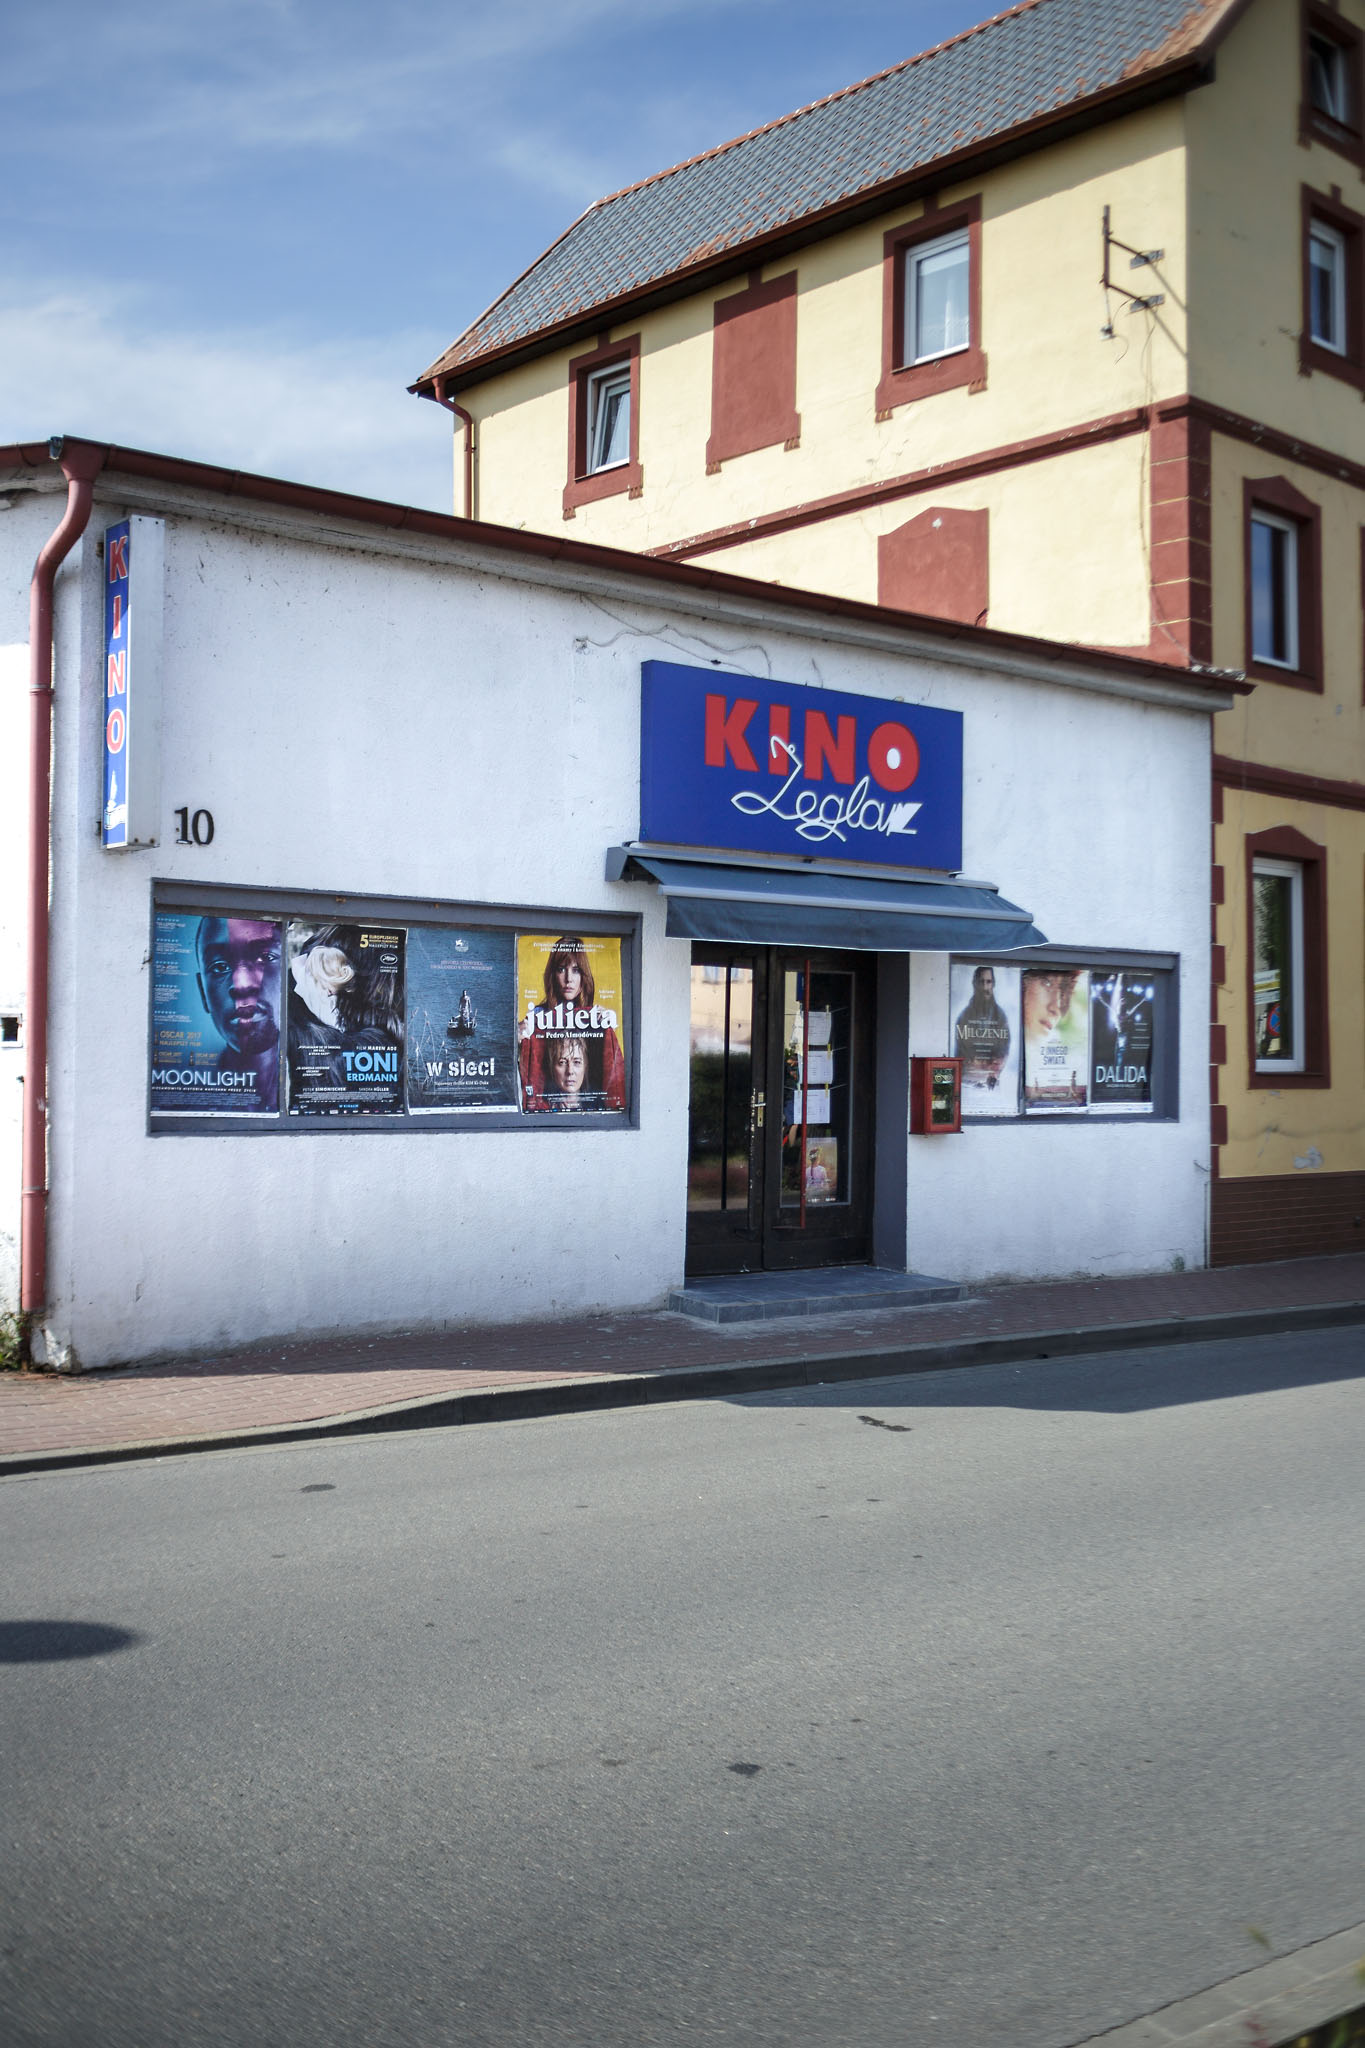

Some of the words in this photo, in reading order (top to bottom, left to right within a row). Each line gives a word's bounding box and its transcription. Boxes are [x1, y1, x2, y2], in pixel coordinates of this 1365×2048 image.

[107, 535, 128, 754] KINO
[704, 693, 920, 793] KINO
[731, 735, 923, 842] Żeglarz
[174, 806, 214, 845] 10
[360, 934, 369, 948] 5
[522, 1002, 618, 1039] julieta
[160, 1030, 184, 1039] OSCAR
[956, 1024, 1009, 1040] MILCZENIE
[342, 1052, 398, 1072] TONI
[152, 1069, 257, 1087] MOONLIGHT
[346, 1073, 398, 1082] ERDMANN
[1096, 1066, 1147, 1083] DALIDA
